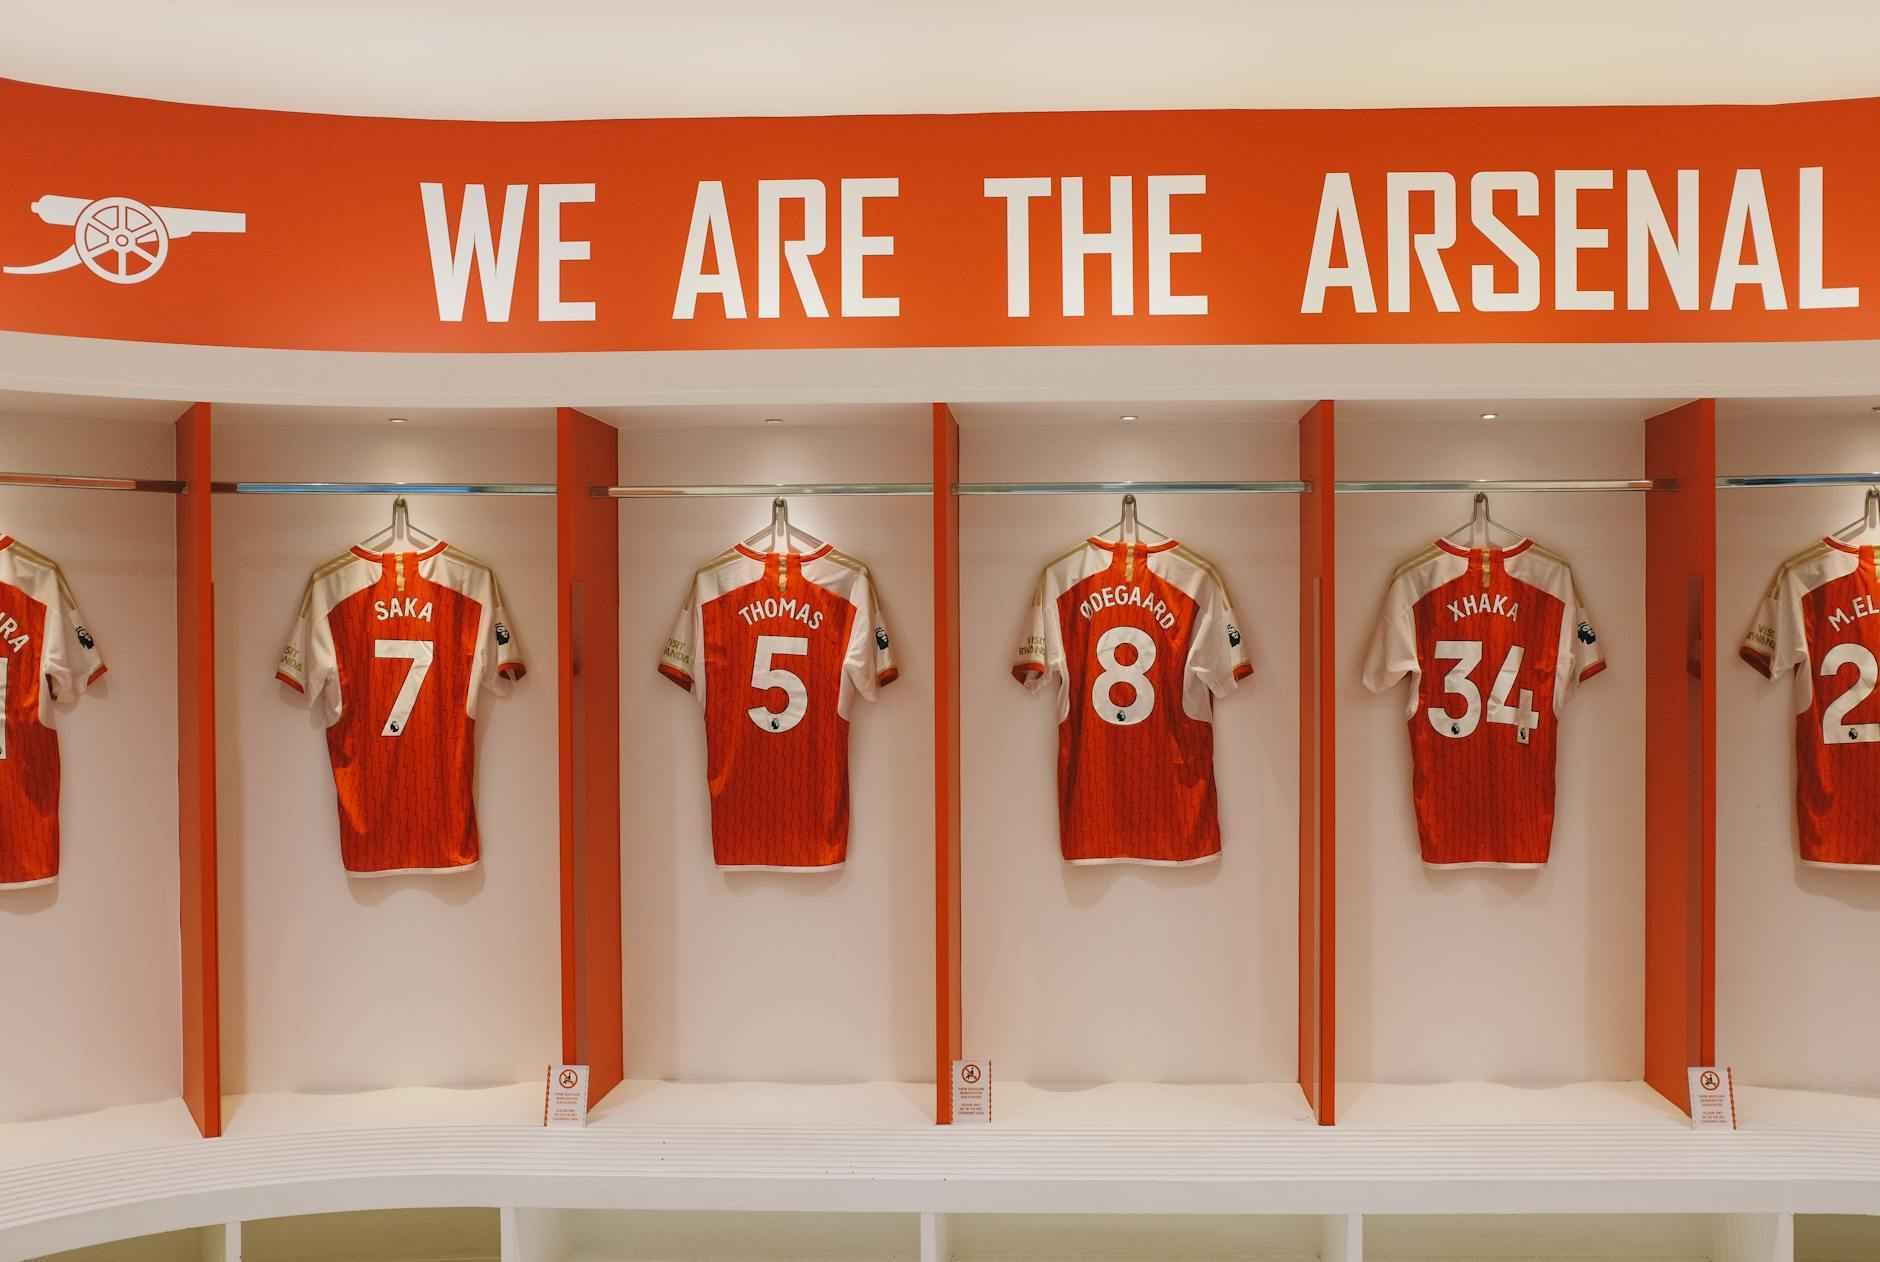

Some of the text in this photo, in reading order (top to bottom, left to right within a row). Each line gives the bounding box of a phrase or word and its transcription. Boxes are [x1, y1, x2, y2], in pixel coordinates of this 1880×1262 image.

[420, 166, 1860, 323] WE ARE THE ARSENAL
[374, 597, 433, 622] SAKA
[737, 597, 825, 631] THOMAS
[1079, 585, 1176, 630] ØDEGAARD
[1446, 592, 1520, 622] XHAKA
[374, 639, 434, 737] 7
[748, 635, 809, 734] 5
[1091, 626, 1157, 726] 8
[1427, 640, 1539, 744] 34
[1821, 643, 1880, 745] 2
